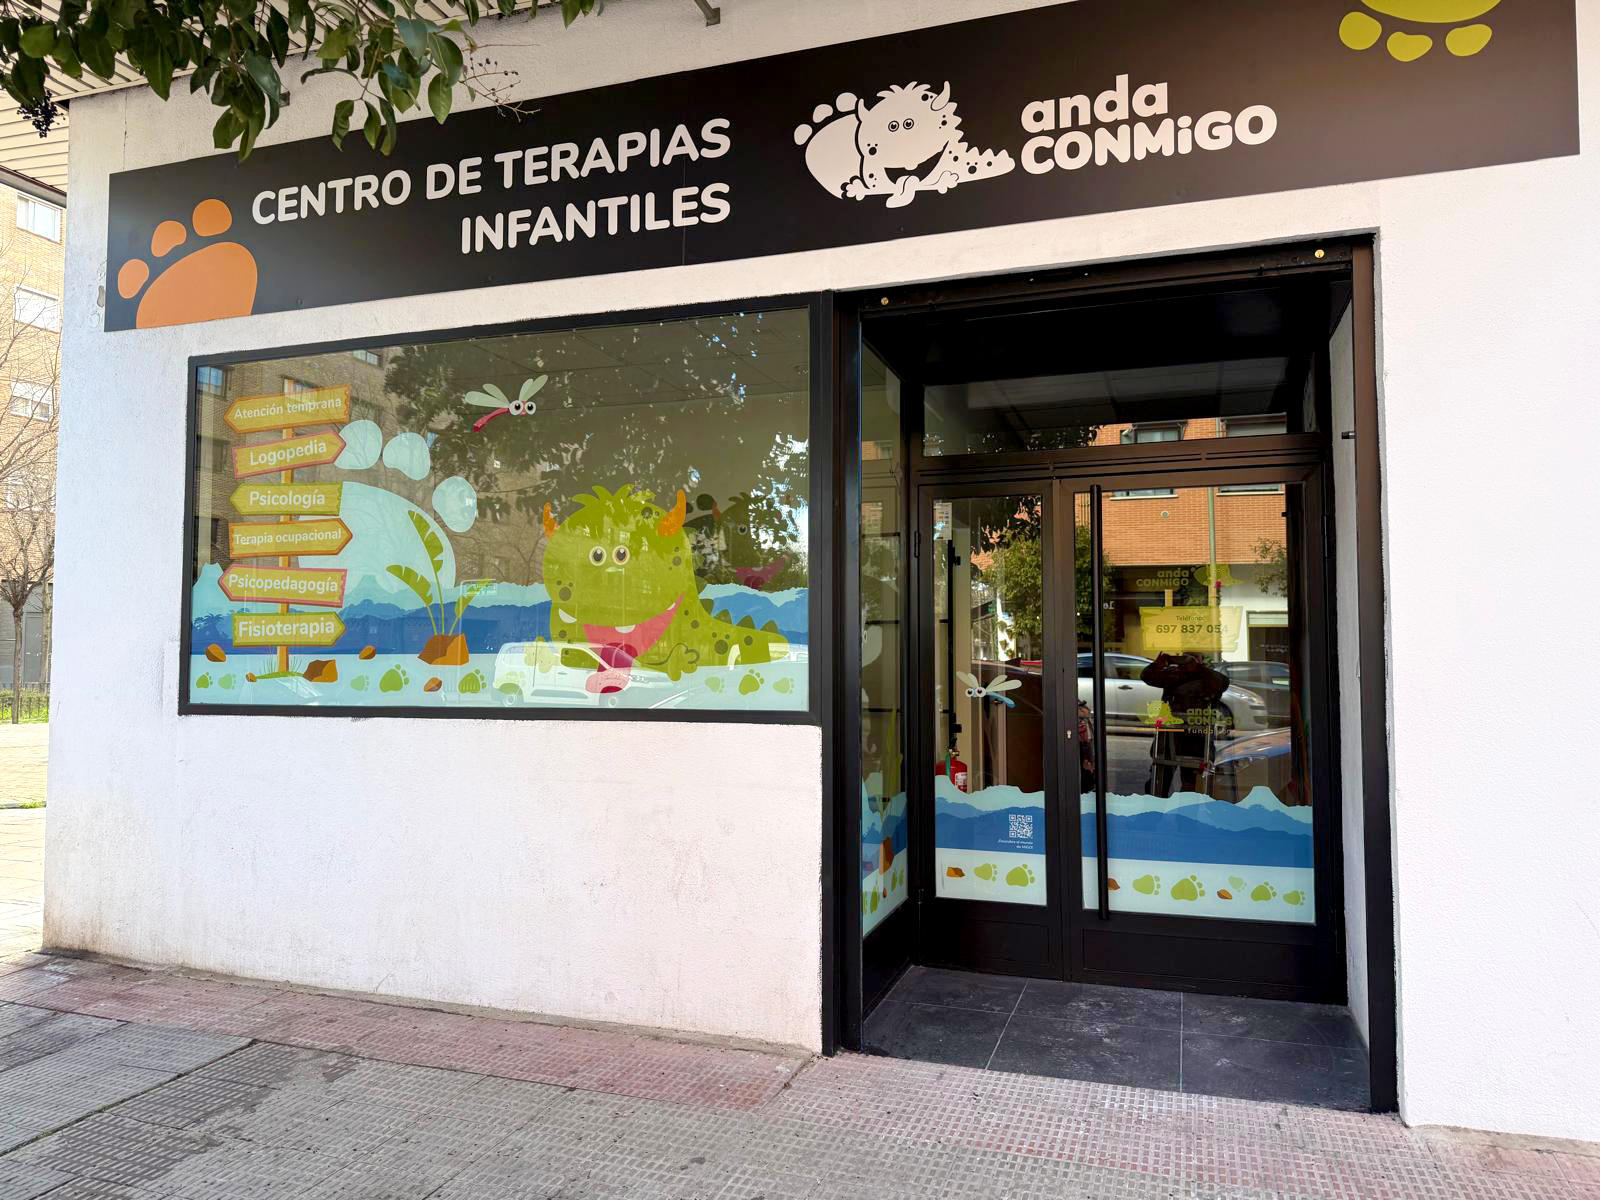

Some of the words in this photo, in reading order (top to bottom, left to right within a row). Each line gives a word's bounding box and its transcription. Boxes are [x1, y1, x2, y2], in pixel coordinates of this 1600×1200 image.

[1021, 73, 1168, 134] anda
[252, 169, 412, 226] CENTRO
[426, 157, 483, 200] DE
[494, 118, 731, 189] TERAPIAS
[461, 182, 731, 255] INFANTILES
[234, 404, 283, 420] Atención
[287, 397, 342, 414] temprana
[250, 439, 327, 466] Logopedia
[249, 489, 326, 508] Psicología
[234, 533, 273, 545] Terapia
[276, 529, 342, 544] ocupacional
[1157, 568, 1189, 578] anda
[228, 574, 338, 594] Psicopedagogía
[238, 617, 336, 638] Fisioterapia
[1156, 624, 1177, 634] 697
[1181, 624, 1203, 634] 837
